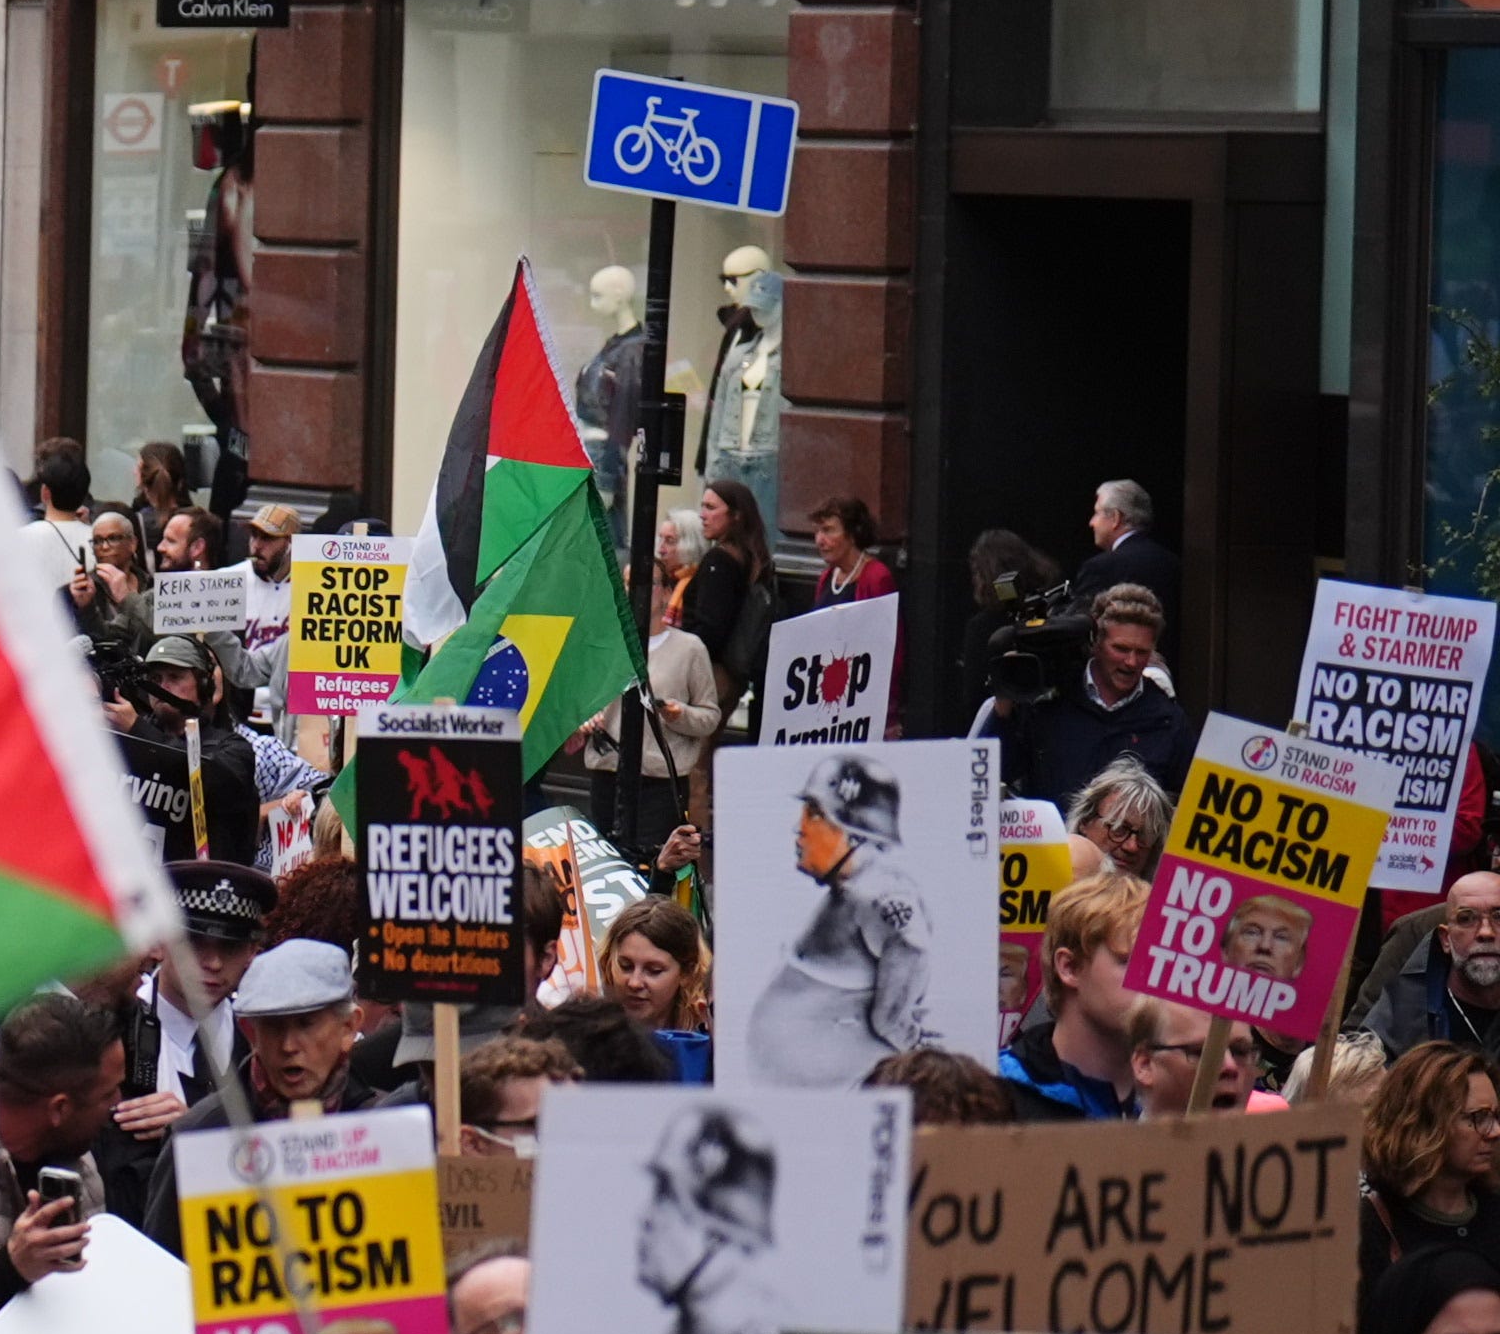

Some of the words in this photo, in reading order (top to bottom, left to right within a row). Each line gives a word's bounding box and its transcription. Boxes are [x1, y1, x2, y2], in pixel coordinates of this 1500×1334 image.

[157, 600, 182, 610] SHAME
[207, 598, 220, 607] YOU
[225, 598, 241, 606] FOR
[159, 579, 192, 596] KEIR
[200, 577, 243, 591] STARMER
[1334, 601, 1405, 636] FIGHT
[1406, 609, 1478, 642] TRUMP
[1338, 635, 1357, 657] &
[1361, 636, 1464, 671] STARMER
[971, 748, 990, 833] PDFiles
[1199, 772, 1264, 825] NO
[1274, 796, 1330, 843] TO
[367, 823, 514, 876] REFUGEES
[1186, 814, 1351, 893] RACISM
[366, 873, 513, 925] WELCOME
[1045, 1164, 1166, 1255] ARE
[1205, 1134, 1348, 1244] NOT
